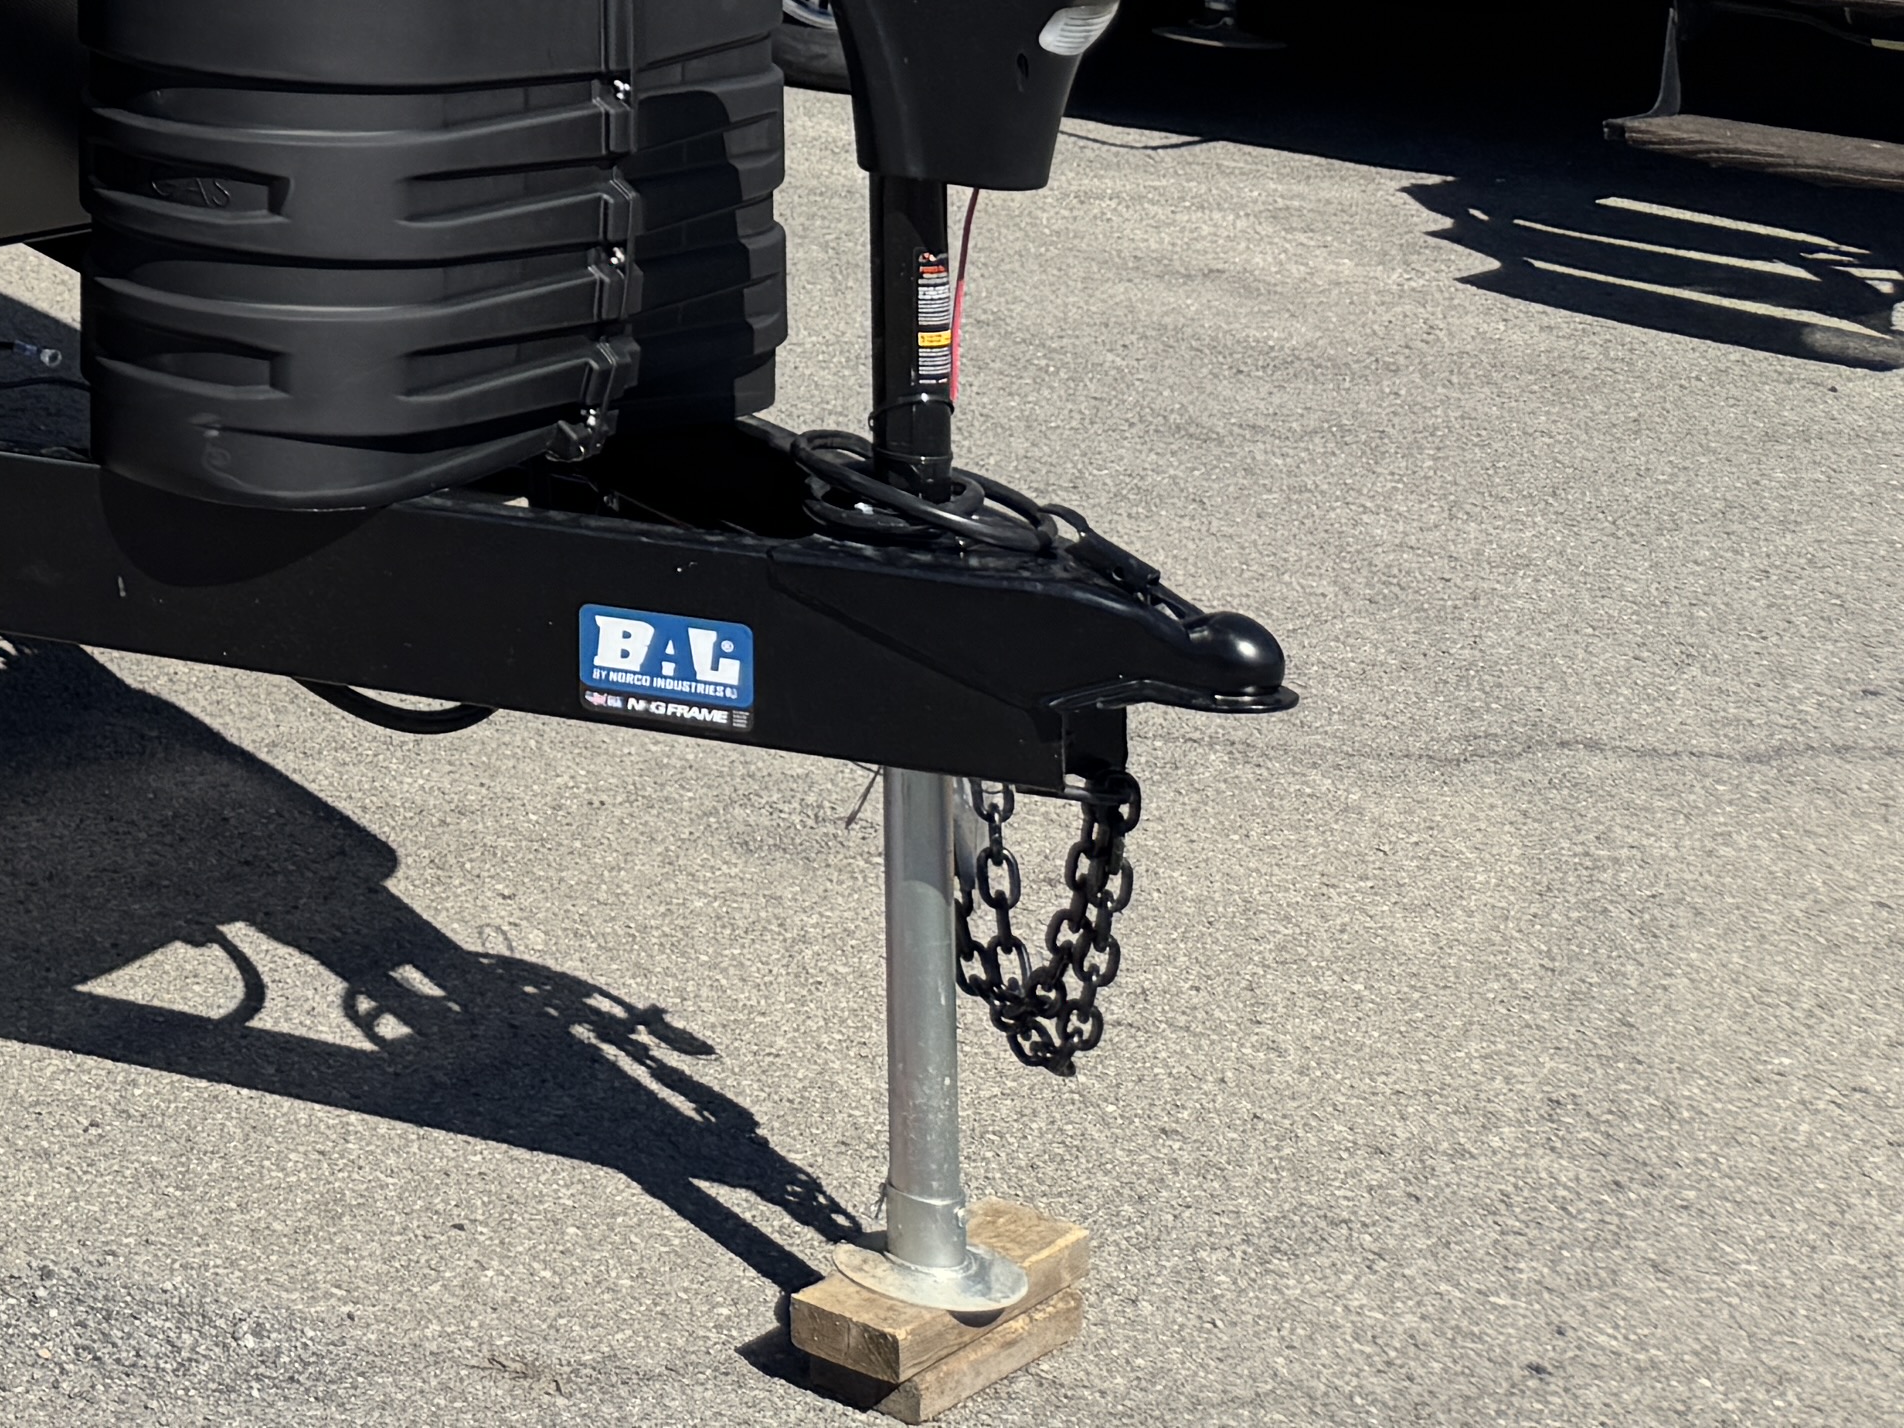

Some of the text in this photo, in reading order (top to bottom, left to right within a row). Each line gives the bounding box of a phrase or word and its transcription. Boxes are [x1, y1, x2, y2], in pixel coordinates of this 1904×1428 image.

[592, 668, 608, 680] BY
[609, 671, 651, 687] NORCO
[653, 677, 725, 697] INDUSTRIES
[667, 703, 729, 724] FRAME
